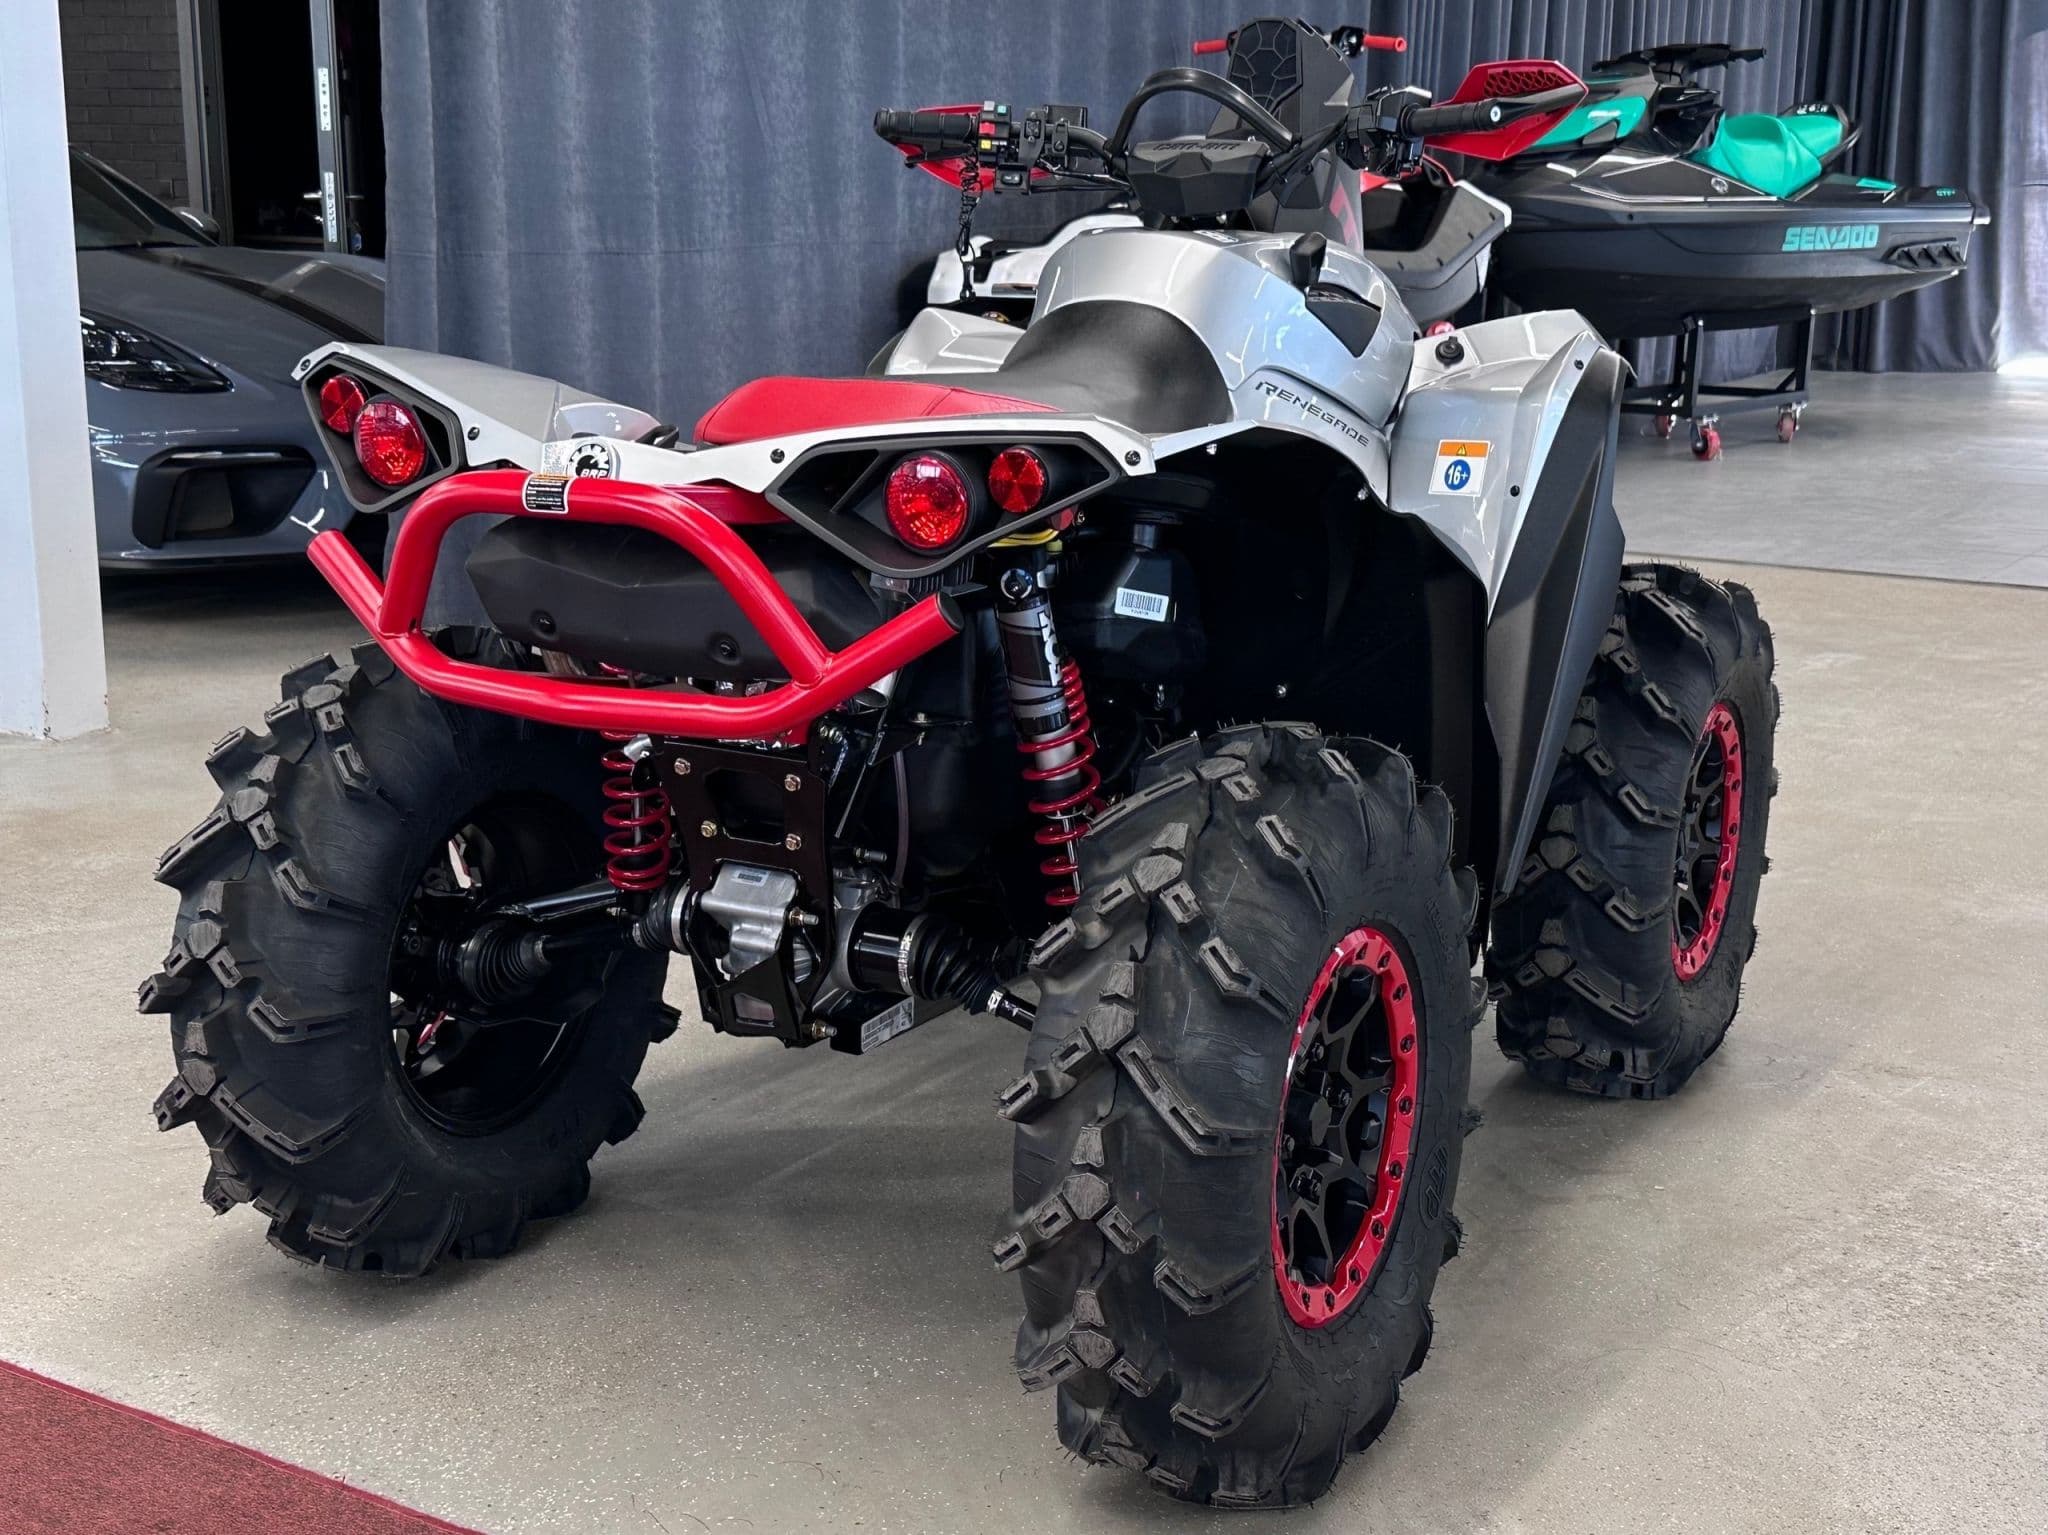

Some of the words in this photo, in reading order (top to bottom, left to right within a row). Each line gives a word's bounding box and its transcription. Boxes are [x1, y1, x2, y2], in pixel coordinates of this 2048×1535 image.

[1255, 381, 1369, 447] RENEGADE
[580, 468, 608, 478] BRP
[1447, 464, 1468, 485] 16+
[1038, 611, 1063, 688] FOX
